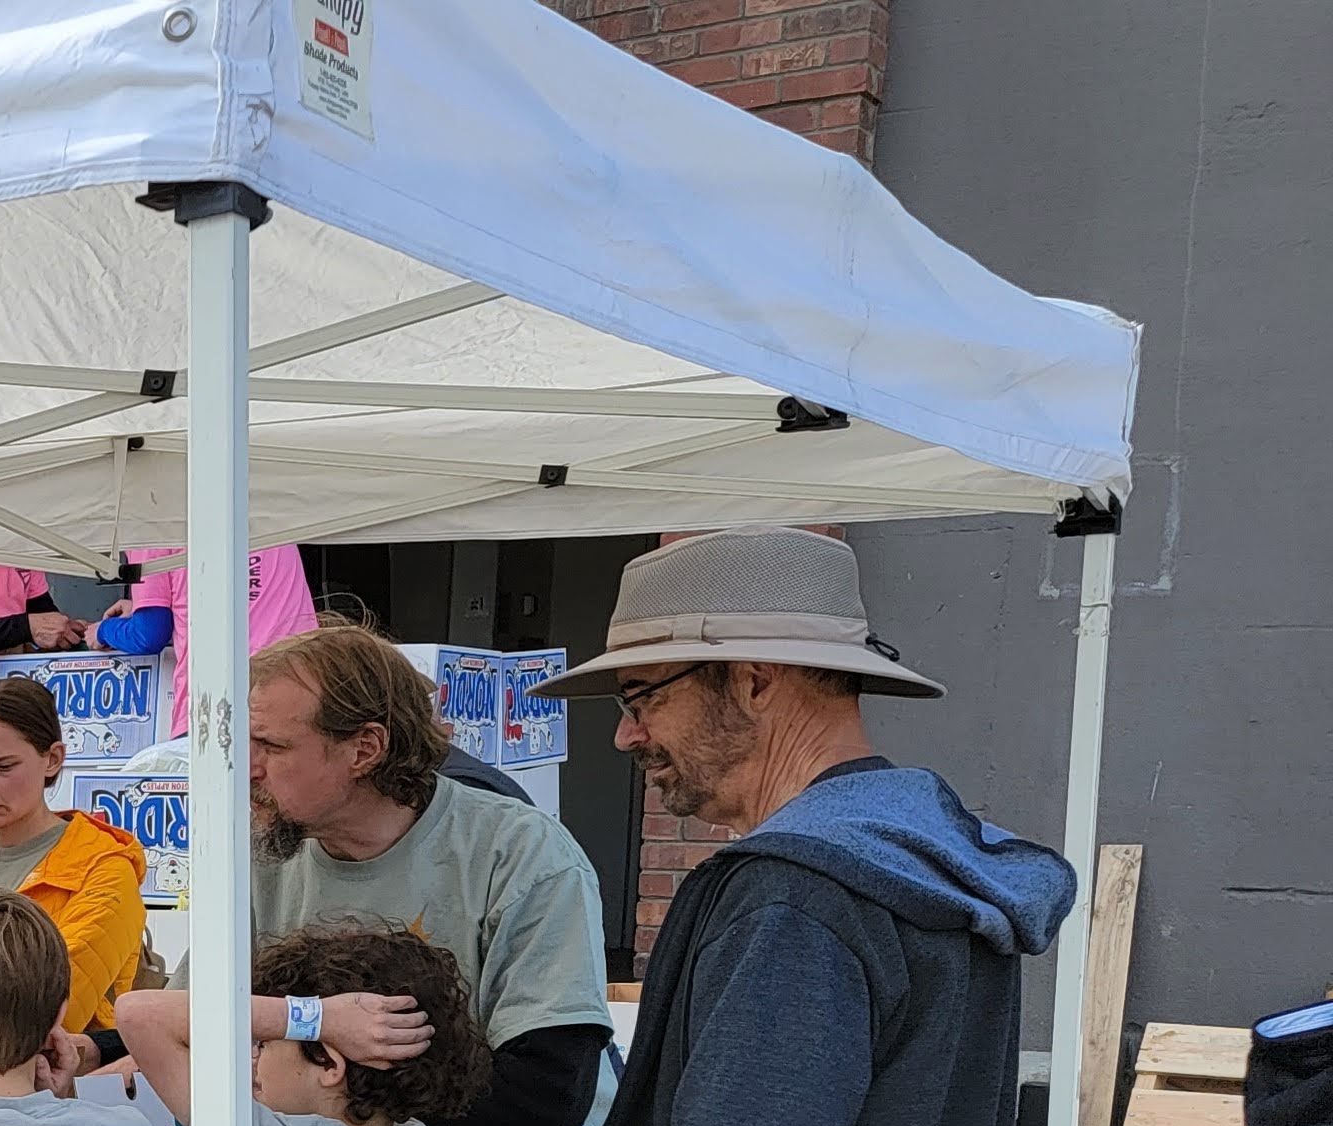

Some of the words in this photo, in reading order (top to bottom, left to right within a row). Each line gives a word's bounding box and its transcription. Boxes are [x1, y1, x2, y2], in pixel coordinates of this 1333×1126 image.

[303, 41, 328, 65] Shade
[328, 51, 359, 82] Products
[442, 669, 498, 722] NORDIC
[146, 782, 170, 791] APPLES
